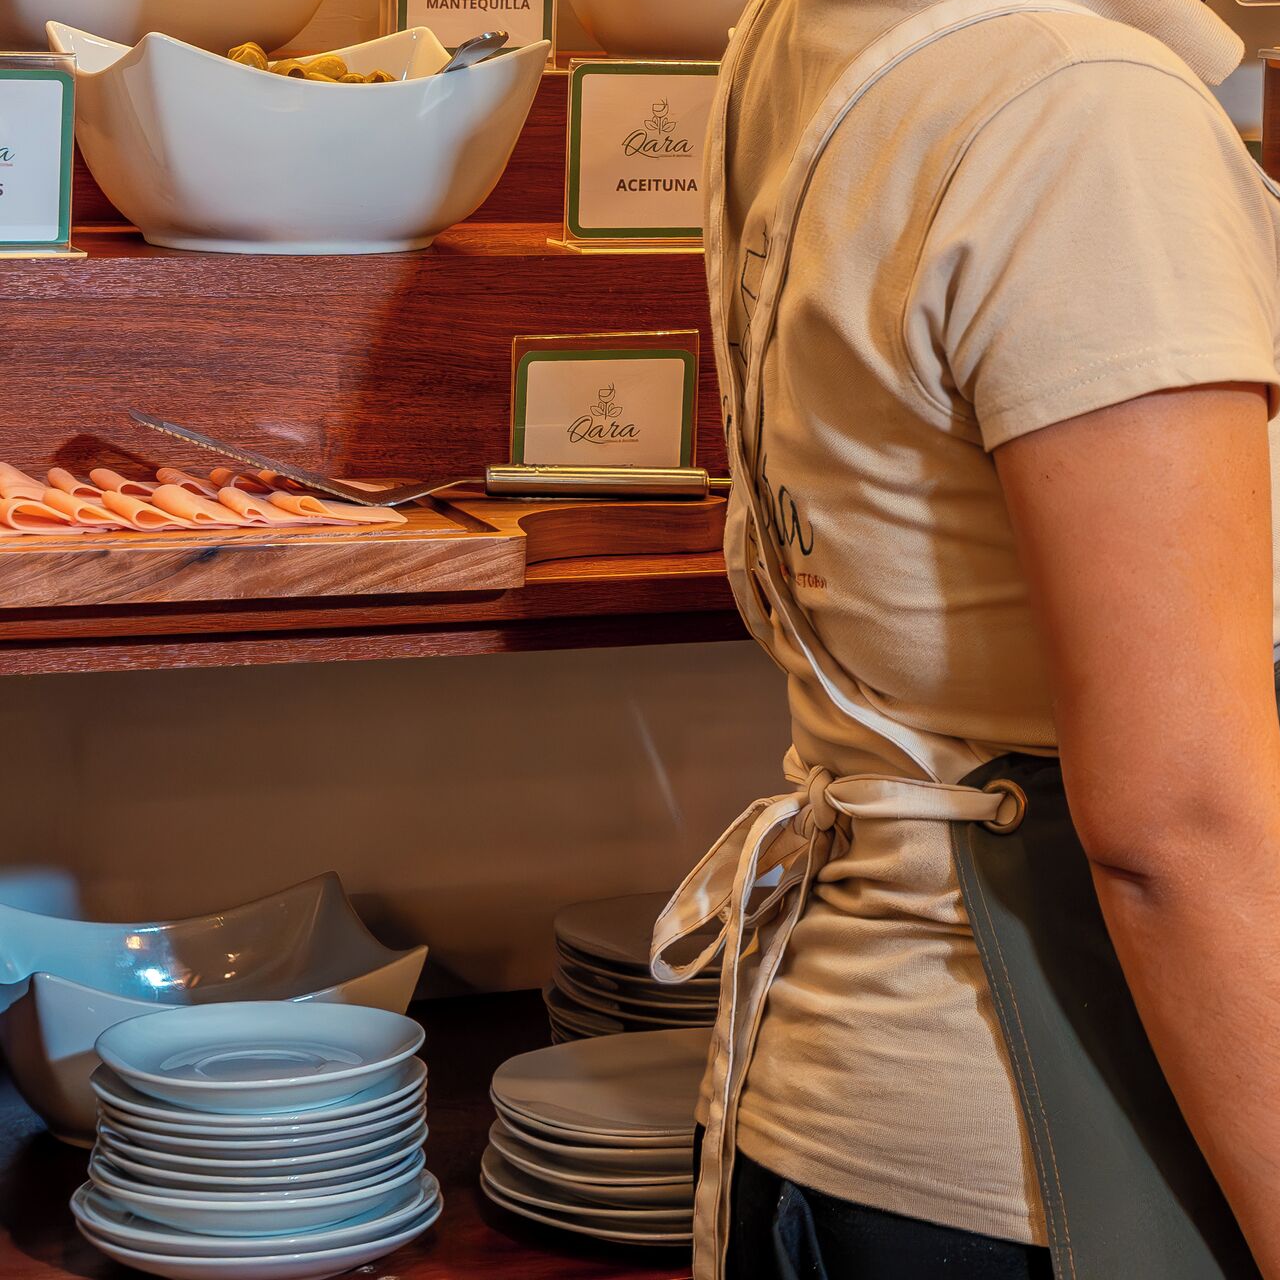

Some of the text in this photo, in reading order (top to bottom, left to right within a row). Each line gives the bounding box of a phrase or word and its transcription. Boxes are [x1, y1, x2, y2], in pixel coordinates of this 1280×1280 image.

[621, 129, 694, 158] Qara
[616, 178, 698, 192] ACEITUNA
[567, 415, 641, 444] Qara
